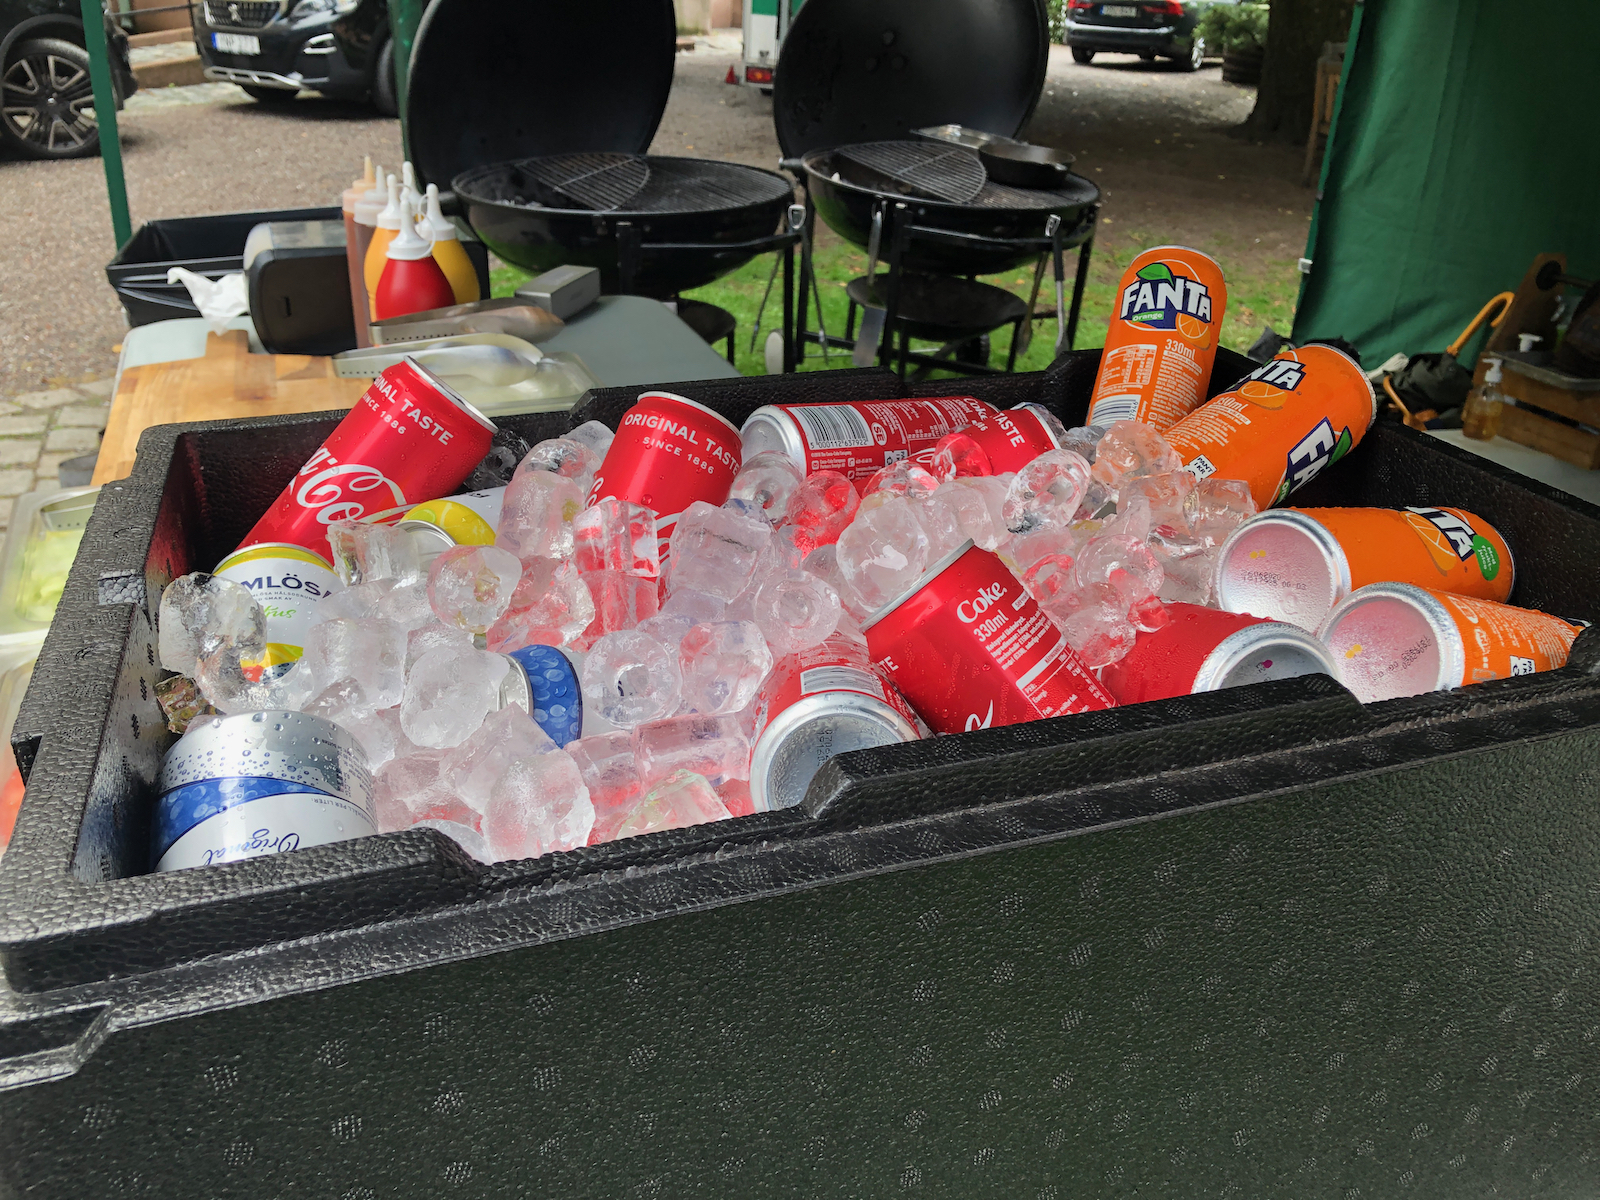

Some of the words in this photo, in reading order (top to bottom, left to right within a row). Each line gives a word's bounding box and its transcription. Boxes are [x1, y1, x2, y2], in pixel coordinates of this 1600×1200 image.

[1120, 277, 1211, 322] FANTA
[1165, 339, 1196, 361] 330ml
[380, 410, 407, 434] 1886
[401, 398, 454, 446] TASTE
[993, 412, 1026, 448] TASTE
[625, 413, 698, 445] ORIGINAL
[706, 438, 741, 476] TASTE
[643, 436, 683, 457] SINCE
[687, 453, 715, 475] 1886
[1197, 457, 1213, 474] PANT
[241, 573, 332, 599] MLÖS
[957, 582, 1008, 624] Coke
[974, 609, 1009, 642] 330ml
